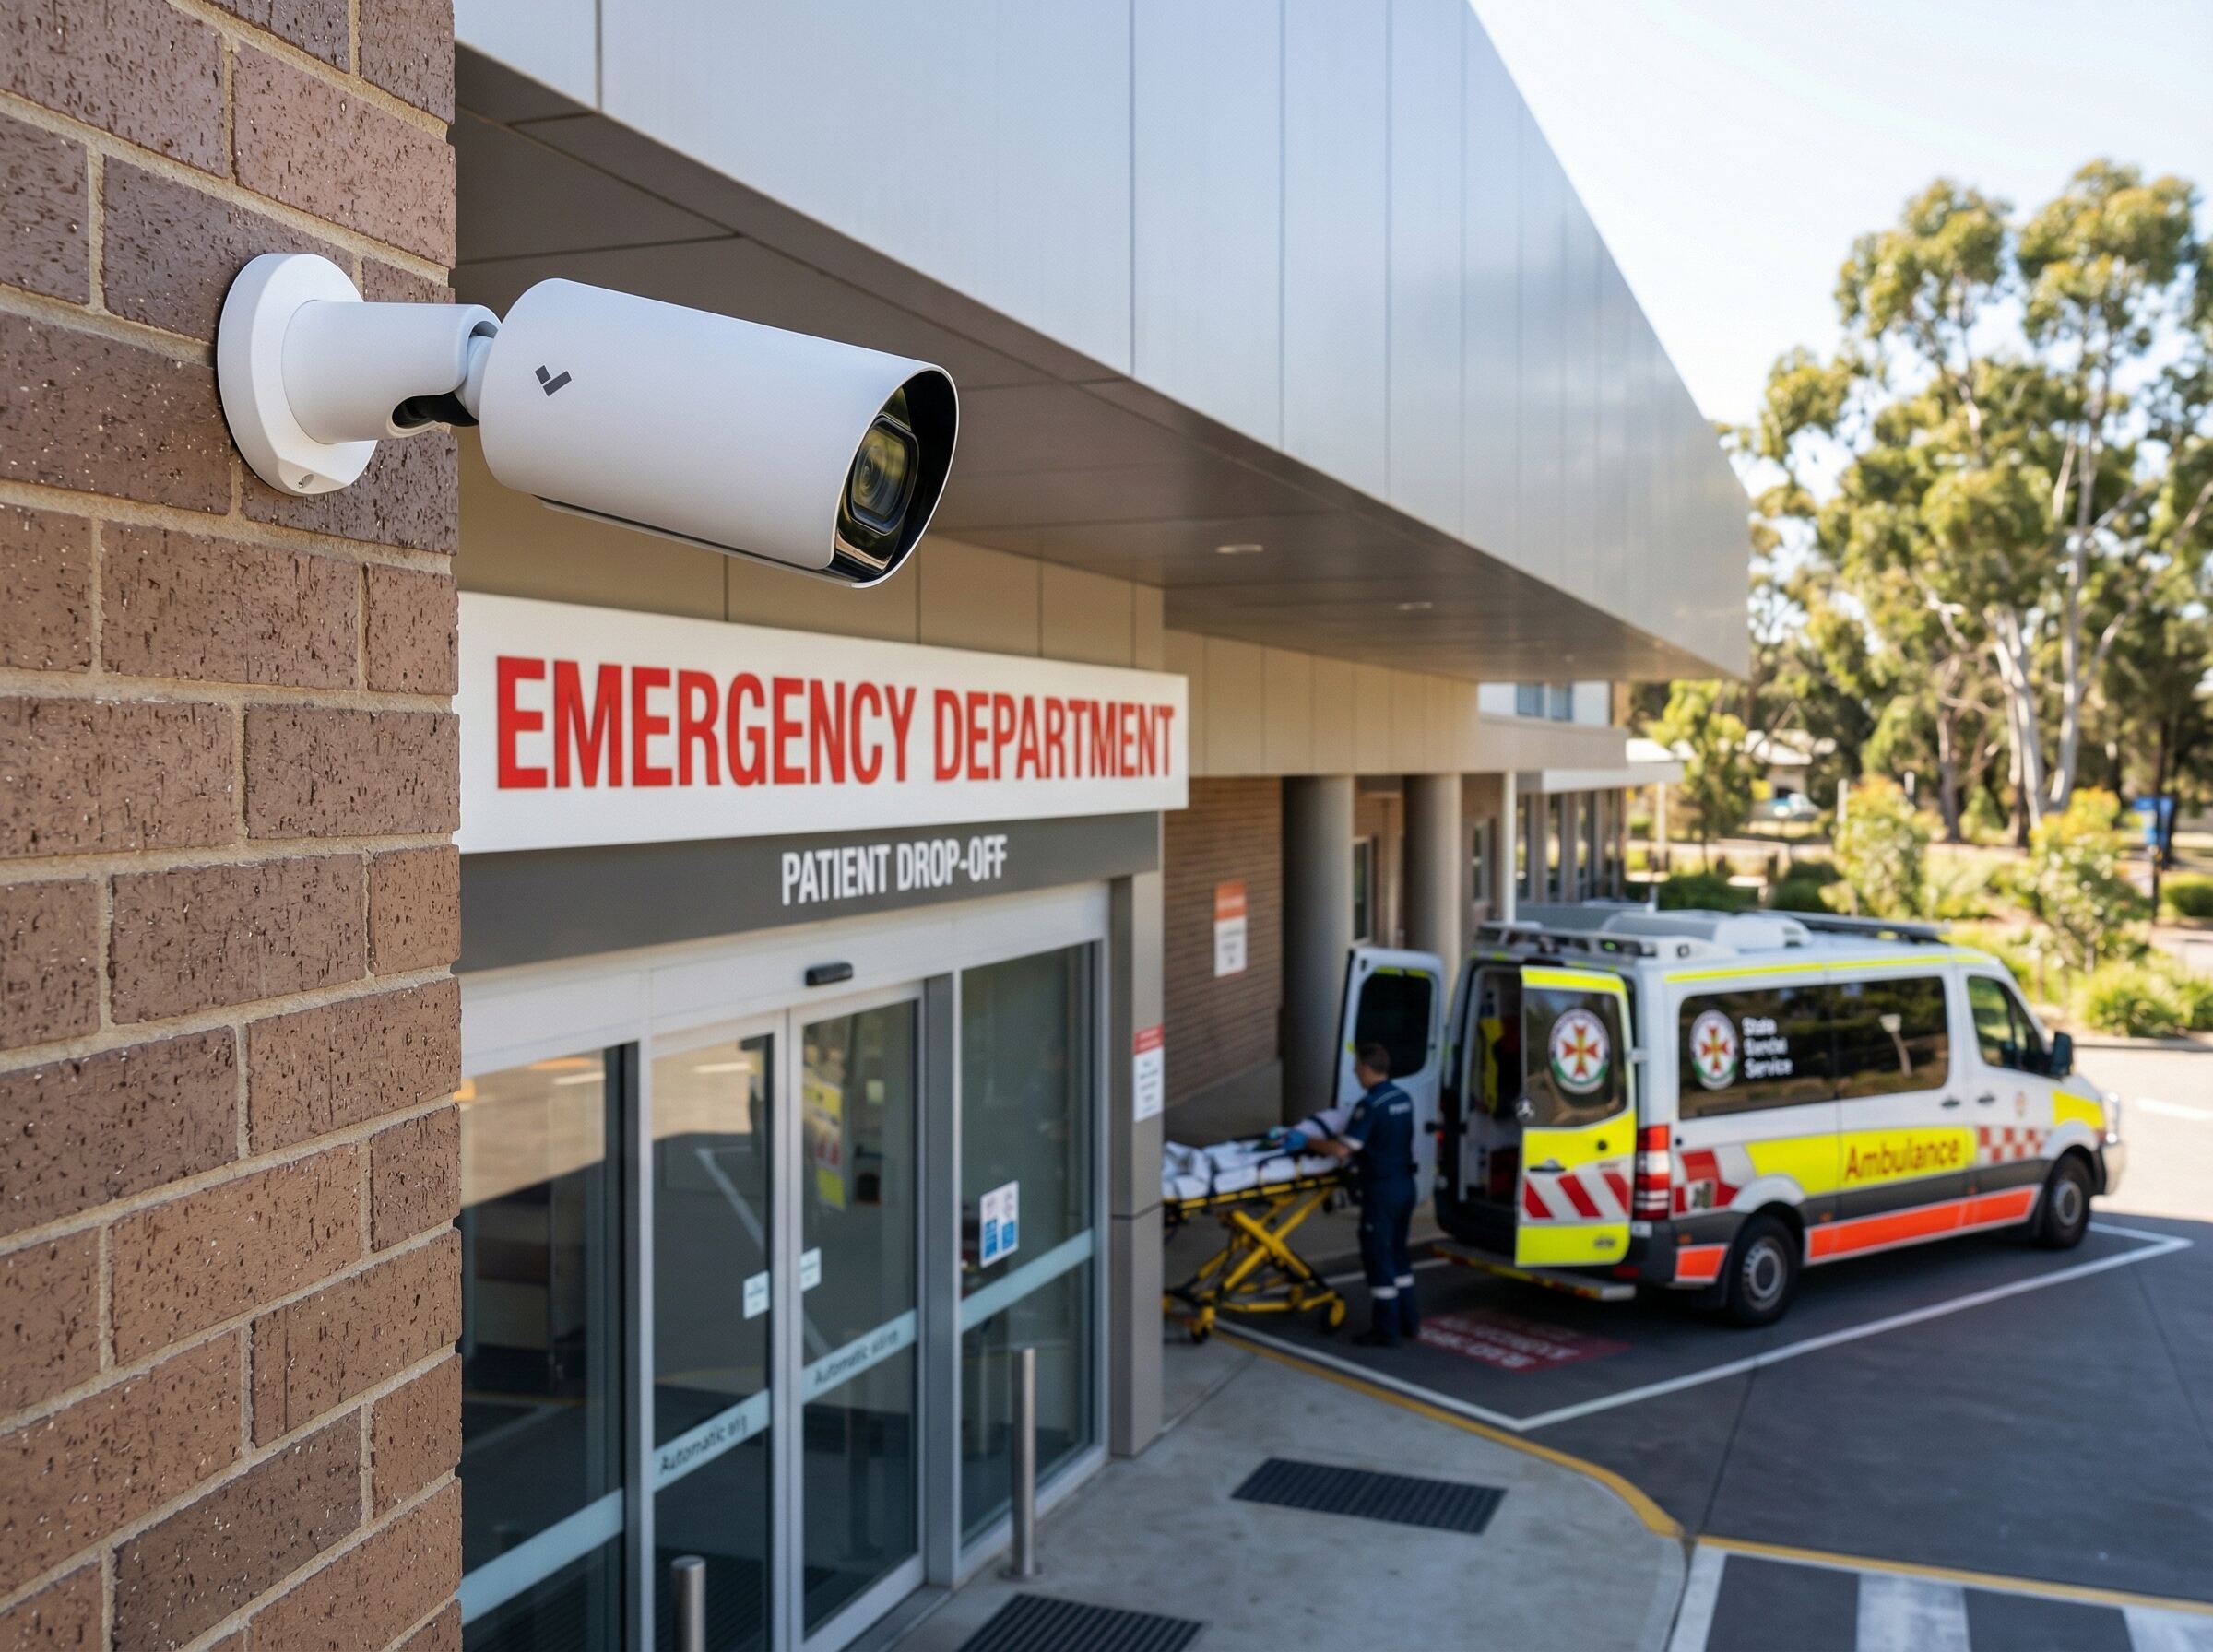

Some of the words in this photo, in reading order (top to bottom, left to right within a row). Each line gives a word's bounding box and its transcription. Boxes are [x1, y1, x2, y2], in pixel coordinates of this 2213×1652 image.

[496, 655, 917, 790] EMERGENCY
[934, 689, 1176, 783] DEPARTMENT
[781, 844, 892, 907] PATIENT
[896, 834, 1008, 892] DROP-OFF
[1744, 1056, 1793, 1080] Service
[1844, 1137, 1960, 1183] Ambulance
[659, 1422, 726, 1475] Automatic
